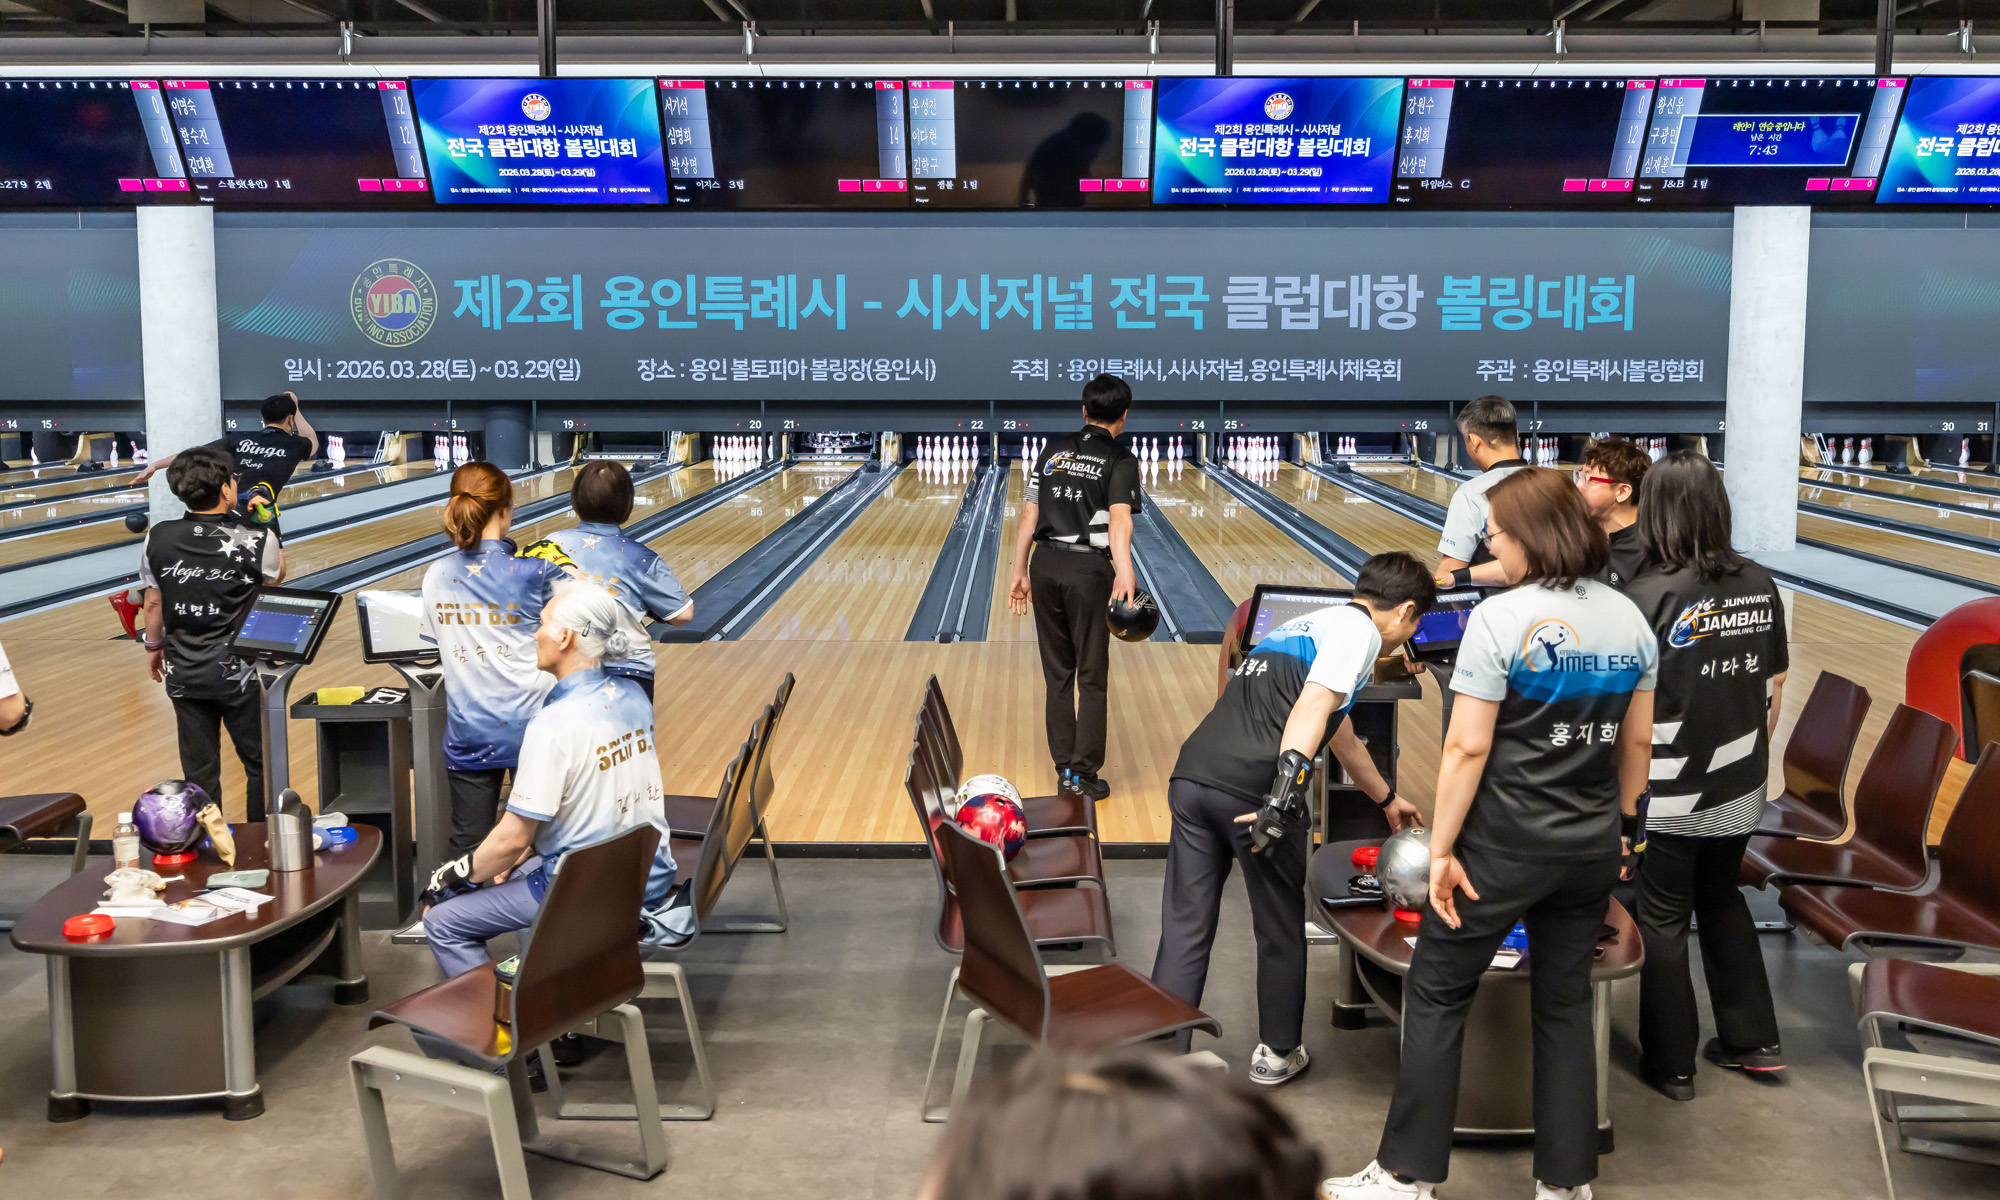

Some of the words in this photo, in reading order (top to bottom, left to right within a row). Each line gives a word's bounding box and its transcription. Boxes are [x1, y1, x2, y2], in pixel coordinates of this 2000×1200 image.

[151, 95, 160, 115] 0
[172, 98, 197, 115] 이명숙
[392, 95, 407, 116] 12
[665, 97, 688, 115] 서기석
[892, 95, 898, 116] 3
[1140, 95, 1146, 115] 0
[1408, 96, 1434, 114] 강원수
[1638, 95, 1646, 114] 0
[1887, 93, 1895, 113] 0
[160, 125, 169, 145] 0
[180, 127, 209, 144] 함수진
[399, 125, 412, 145] 12
[478, 125, 506, 136] 제2회
[508, 125, 556, 136] 용인특례시
[564, 125, 603, 136] 시사저널
[668, 127, 691, 145] 심명희
[889, 126, 899, 145] 14
[912, 128, 938, 145] 이다현
[1135, 125, 1145, 145] 12
[1215, 124, 1242, 135] 제2회
[1244, 124, 1293, 135] 용인특례시
[1301, 124, 1340, 135] 시사저널
[1404, 126, 1431, 144] 홍지희
[1627, 125, 1640, 145] 12
[1878, 124, 1887, 143] 0
[1956, 124, 1985, 135] 제2회
[1987, 124, 2000, 135] 용
[446, 138, 484, 158] 전국
[488, 138, 560, 157] 클럽대항
[564, 138, 637, 157] 볼링대회
[1178, 137, 1216, 158] 전국
[1220, 138, 1293, 157] 클럽대항
[1297, 138, 1370, 157] 볼링대회
[1750, 145, 1778, 155] 7:43
[1916, 137, 1954, 157] 전국
[169, 154, 178, 173] 0
[409, 155, 419, 174] 2
[894, 155, 901, 174] 0
[914, 156, 939, 174] 김학구
[1138, 155, 1144, 174] 0
[1625, 155, 1632, 174] 0
[1869, 153, 1878, 173] 0
[696, 180, 720, 189] 이지스
[1421, 180, 1452, 189] 타임리스
[1461, 180, 1469, 188] C
[1663, 180, 1684, 188] J&B
[370, 293, 418, 314] YIBA
[453, 274, 582, 330] 제2회
[600, 274, 845, 330] 용인특례시
[896, 274, 1092, 329] 시사저널
[1109, 274, 1209, 330] 전국
[1223, 274, 1424, 330] 클럽대항
[1437, 275, 1635, 330] 볼링대회
[689, 358, 726, 381] 용인
[731, 358, 807, 381] 볼토피아
[810, 358, 936, 381] 볼링장(용인시)
[1532, 359, 1703, 382] 용인특례시볼링협회
[7, 420, 17, 428] 14
[42, 420, 52, 428] 15
[227, 420, 236, 428] 16
[563, 420, 573, 428] 19
[750, 420, 761, 429] 20
[784, 420, 794, 428] 21
[971, 421, 983, 429] 22
[1004, 421, 1016, 429] 23
[1192, 421, 1205, 429] 24
[1225, 421, 1237, 429] 25
[1415, 421, 1427, 429] 26
[1942, 422, 1954, 431] 30
[1977, 422, 1988, 431] 31
[237, 439, 286, 457] Bingo
[160, 559, 205, 585] Aegis
[175, 603, 219, 616] 심명희
[1722, 595, 1771, 607] JUNWAVE
[436, 602, 483, 625] SPLIT
[487, 602, 521, 625] B.C
[1699, 609, 1773, 633] JAMBALL
[1720, 626, 1754, 638] BOWLING
[1755, 624, 1771, 633] CLUB
[453, 644, 512, 665] 함수진
[1550, 723, 1618, 746] 홍지희
